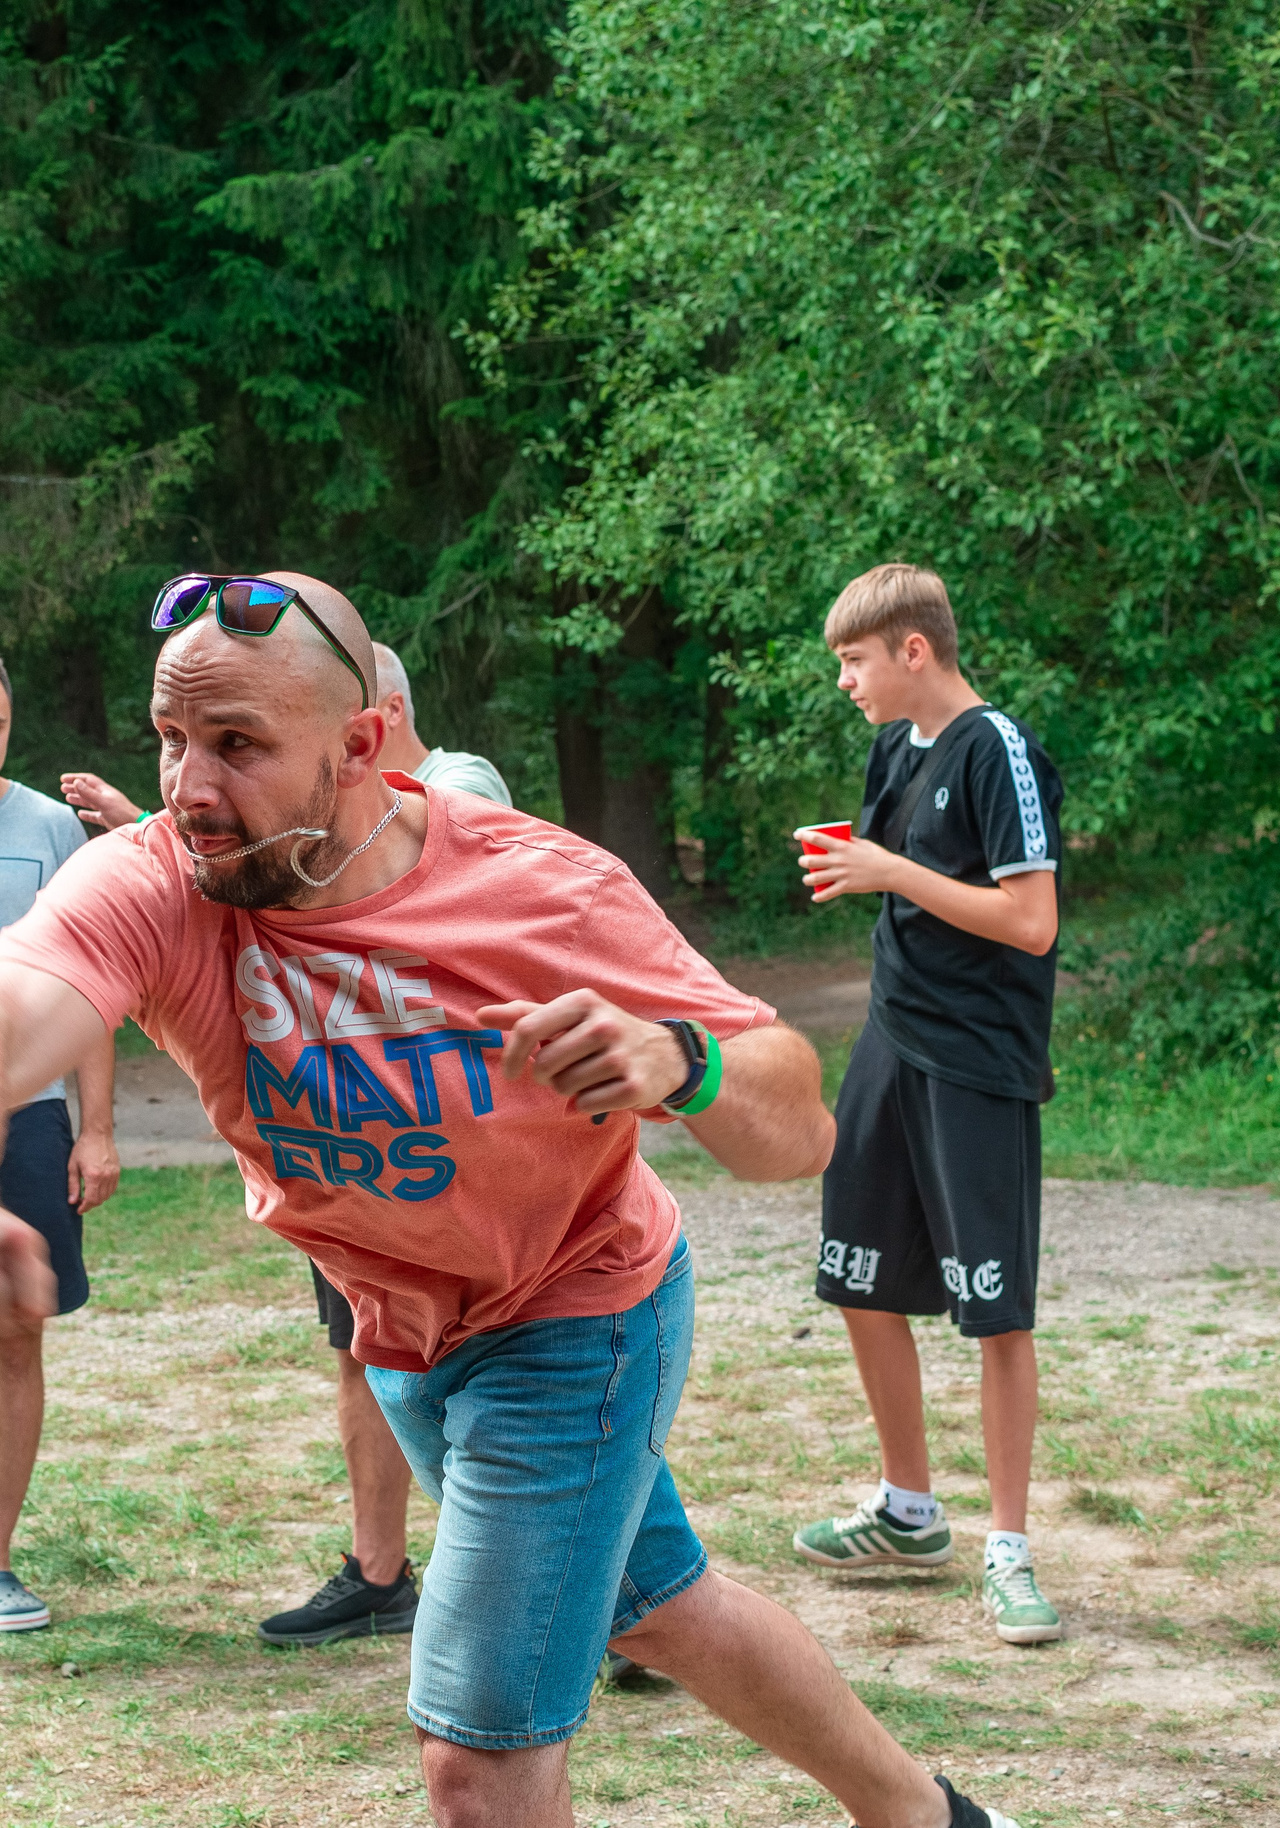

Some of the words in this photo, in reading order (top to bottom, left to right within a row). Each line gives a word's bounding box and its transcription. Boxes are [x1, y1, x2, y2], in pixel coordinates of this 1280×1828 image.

[235, 944, 448, 1043] SIZE
[245, 1029, 504, 1133] MATT
[256, 1123, 458, 1203] ERS
